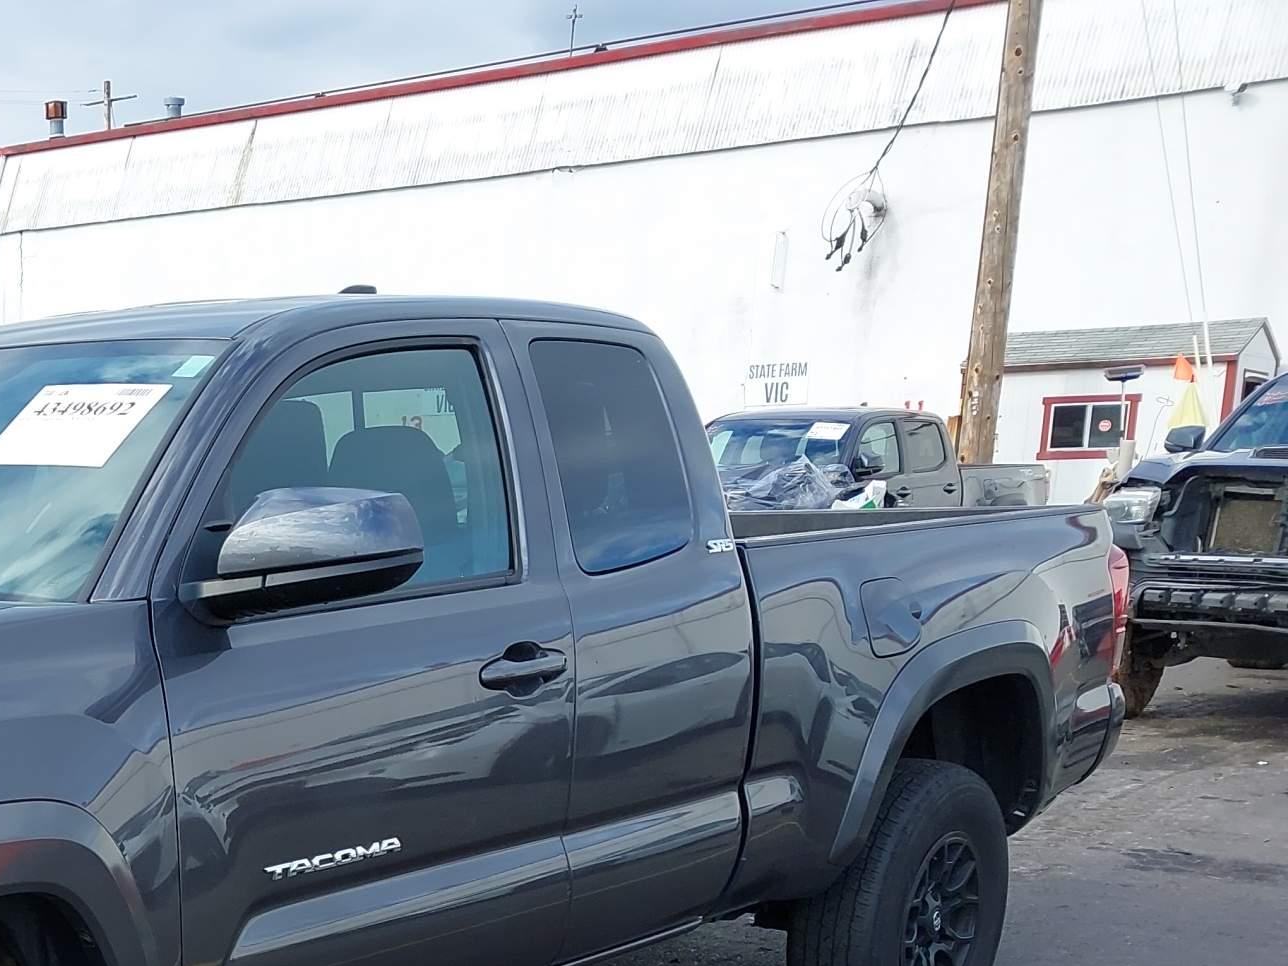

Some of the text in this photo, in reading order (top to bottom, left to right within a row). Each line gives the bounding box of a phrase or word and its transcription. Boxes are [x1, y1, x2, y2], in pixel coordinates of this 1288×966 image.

[749, 361, 808, 380] STATE FARM
[764, 381, 789, 403] VIC
[33, 402, 136, 417] 43498692
[264, 837, 403, 881] TACOMA
